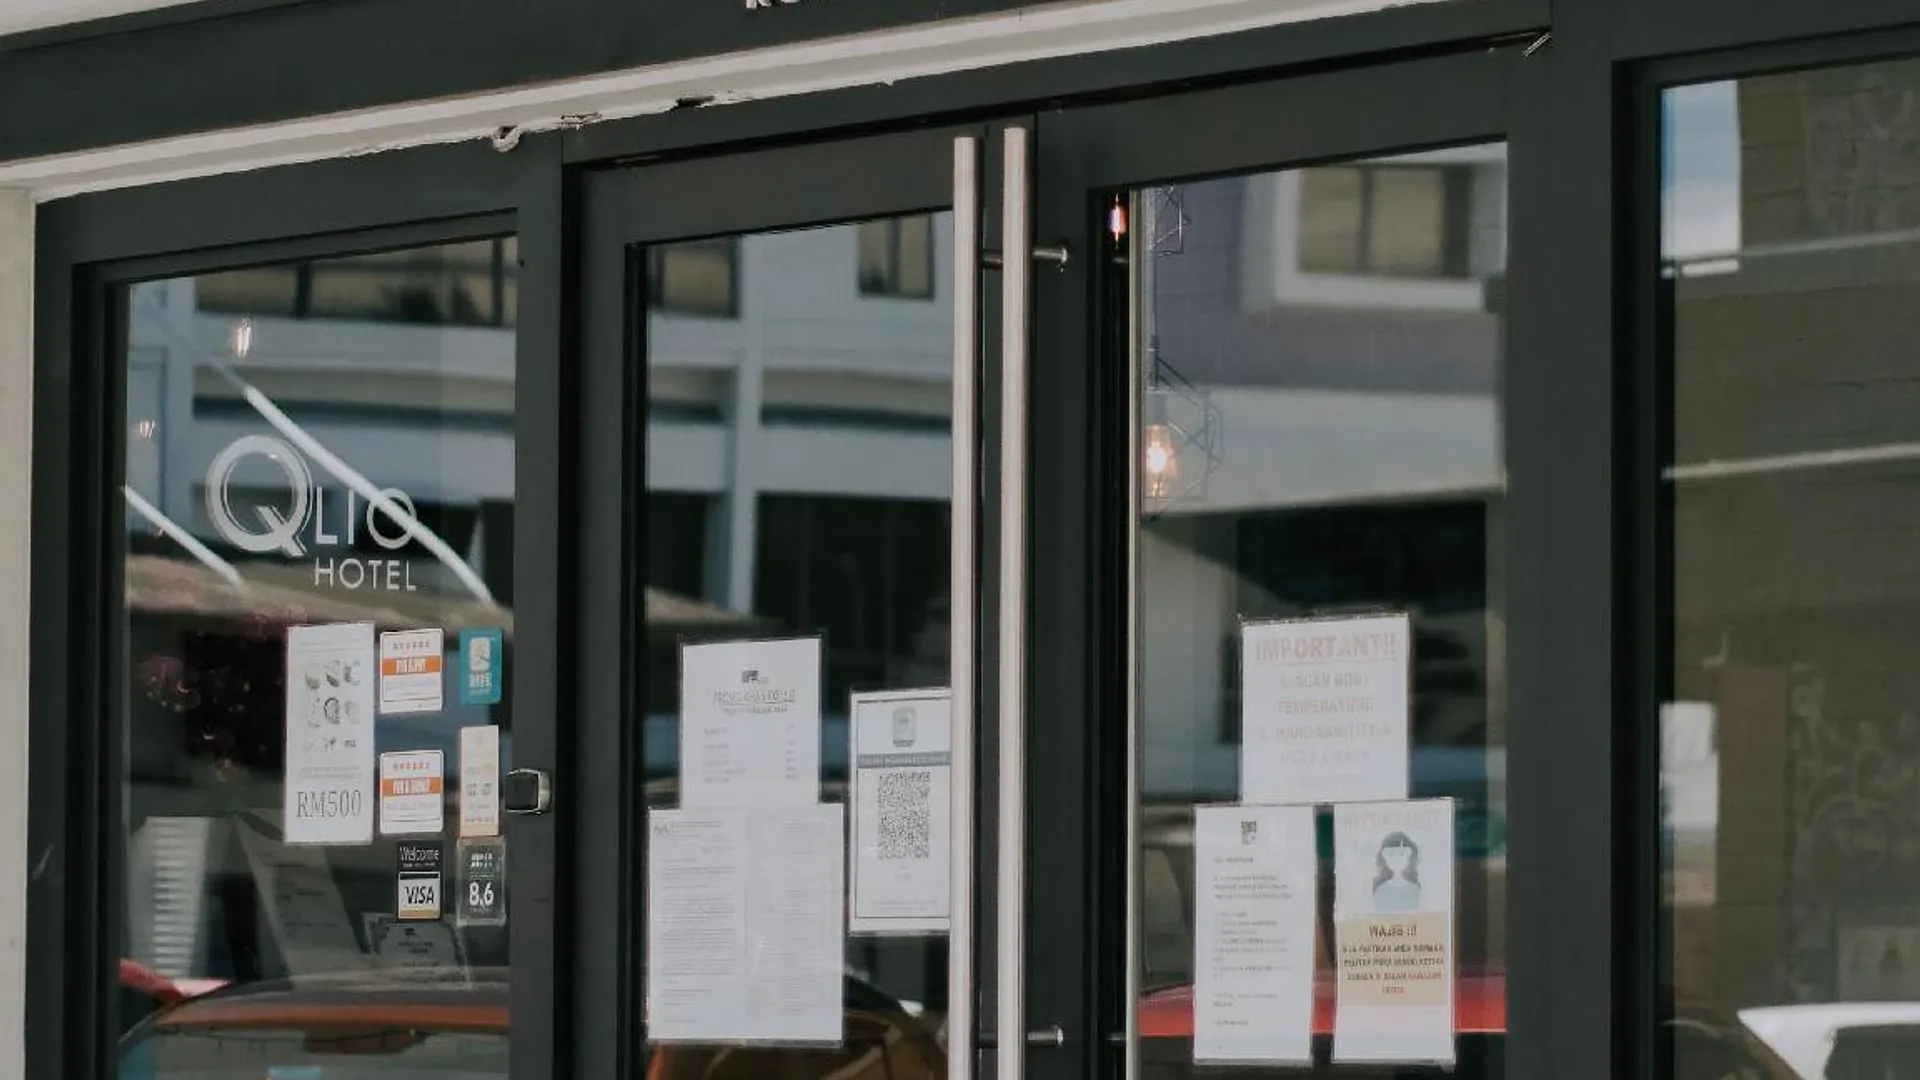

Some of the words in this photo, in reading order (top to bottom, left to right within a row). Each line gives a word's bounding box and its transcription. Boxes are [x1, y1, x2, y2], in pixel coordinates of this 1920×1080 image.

[205, 434, 417, 557] QLIO
[314, 557, 417, 591] HOTEL
[1255, 633, 1396, 662] IMPORTANT!!
[296, 789, 362, 818] RM500
[400, 846, 439, 861] Welcome
[404, 886, 435, 904] VISA
